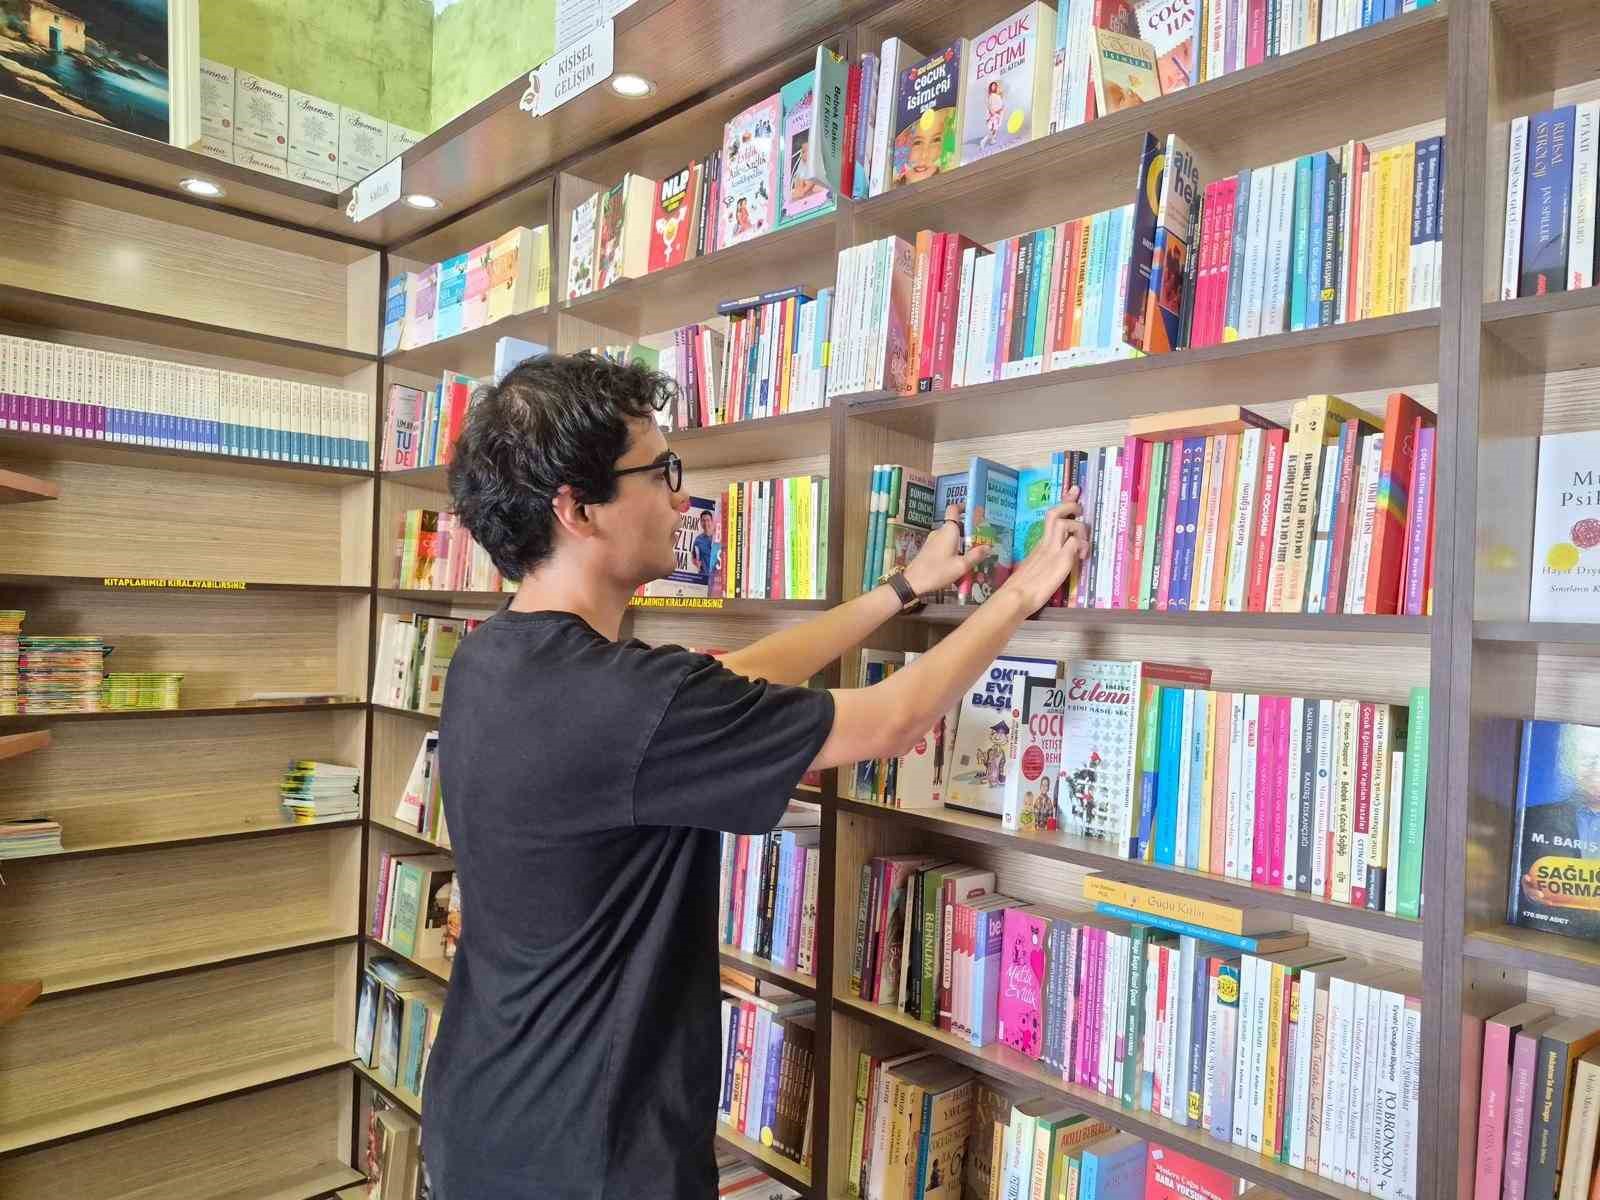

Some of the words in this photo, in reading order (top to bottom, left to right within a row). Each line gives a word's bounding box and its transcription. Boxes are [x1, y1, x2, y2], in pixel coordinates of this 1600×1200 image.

[975, 15, 1030, 61] ÇOCUK
[1175, 150, 1199, 181] aile
[662, 169, 690, 200] NLP
[1235, 512, 1246, 546] Karakter
[1363, 707, 1371, 729] Çocuk
[1361, 731, 1370, 771] Eğitiminde
[1341, 781, 1350, 802] Bebek
[1359, 773, 1368, 800] Yapılan
[1300, 801, 1311, 847] KISKANÇLIĞI
[1338, 813, 1348, 833] Çocuk
[1359, 802, 1367, 831] Hatalar
[1337, 835, 1347, 857] Sağlığı
[1531, 833, 1549, 845] M.
[924, 913, 934, 979] REHNUMA
[1374, 1094, 1382, 1125] ASHLEY
[1385, 1091, 1397, 1110] PO
[1372, 1127, 1380, 1174] MERRYMAN
[1381, 1112, 1396, 1178] BRONSON
